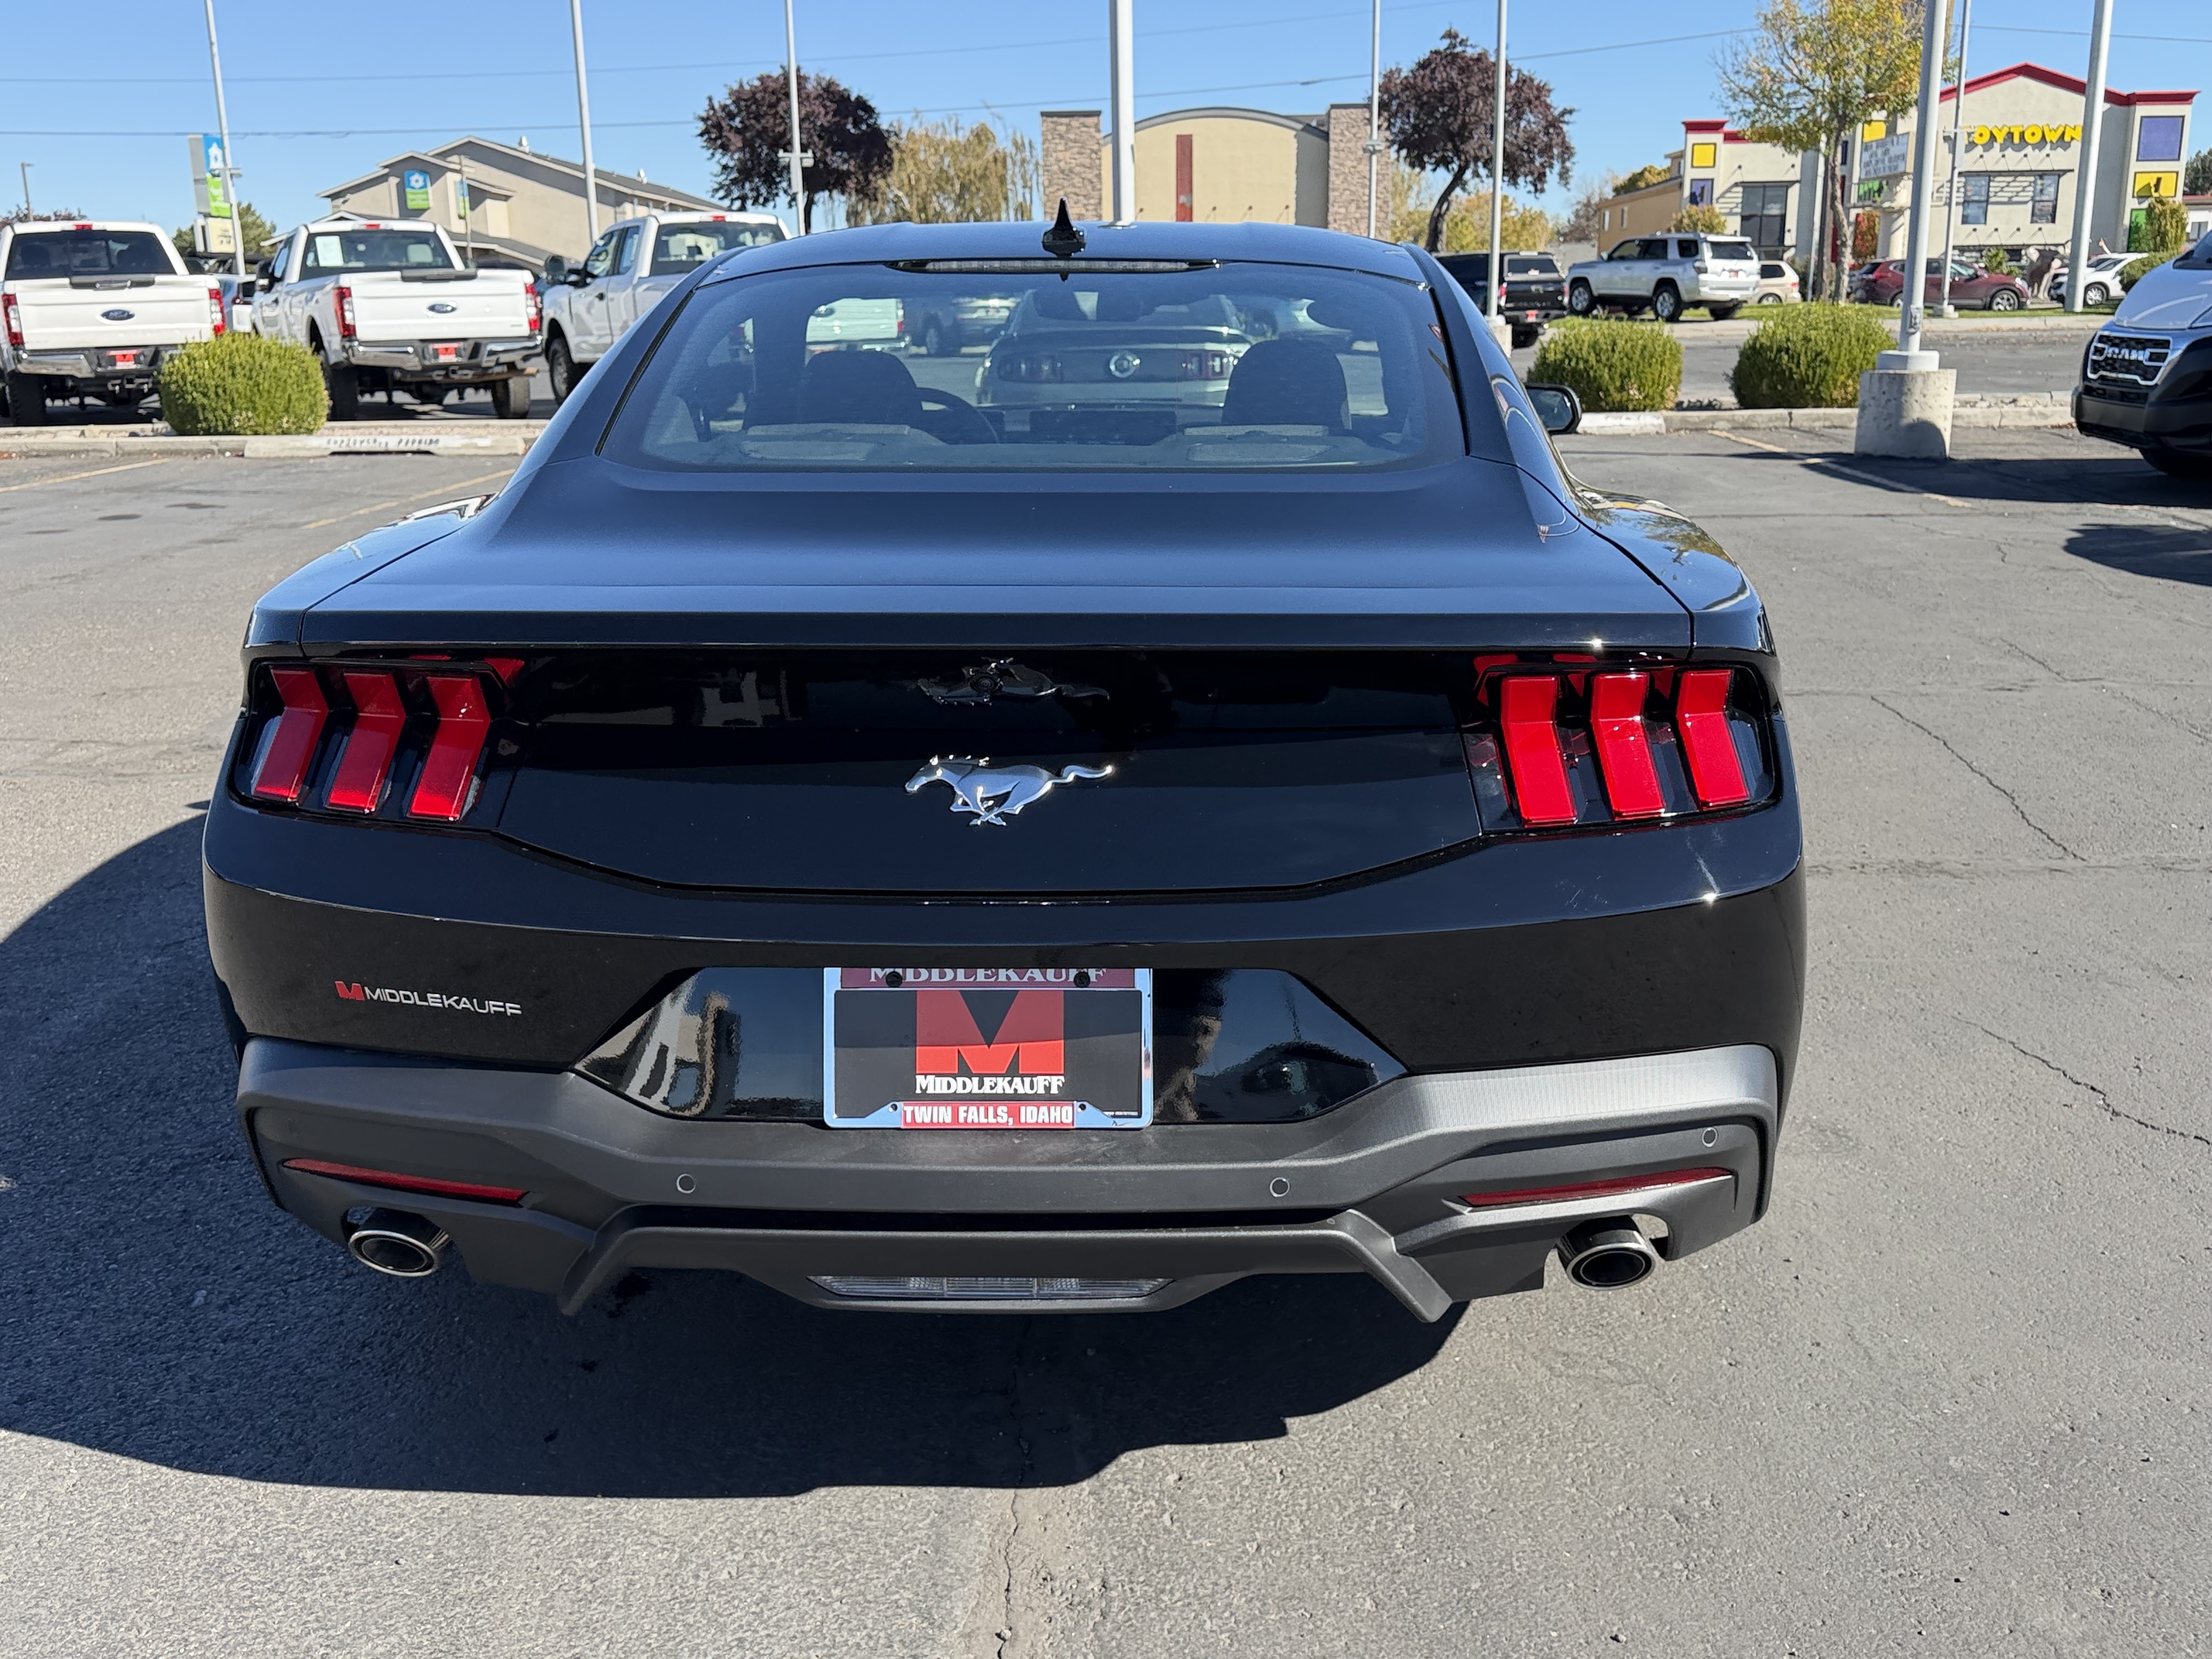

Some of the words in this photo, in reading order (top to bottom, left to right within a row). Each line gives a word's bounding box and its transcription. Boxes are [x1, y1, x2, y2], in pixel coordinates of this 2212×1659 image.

[365, 986, 522, 1016] MIDDLEKAUFF
[915, 1075, 1065, 1094] MIDDLEKAUFF
[903, 1104, 952, 1124] TWIN
[958, 1104, 1013, 1126] FALLS,
[1020, 1104, 1073, 1124] IDAHO
